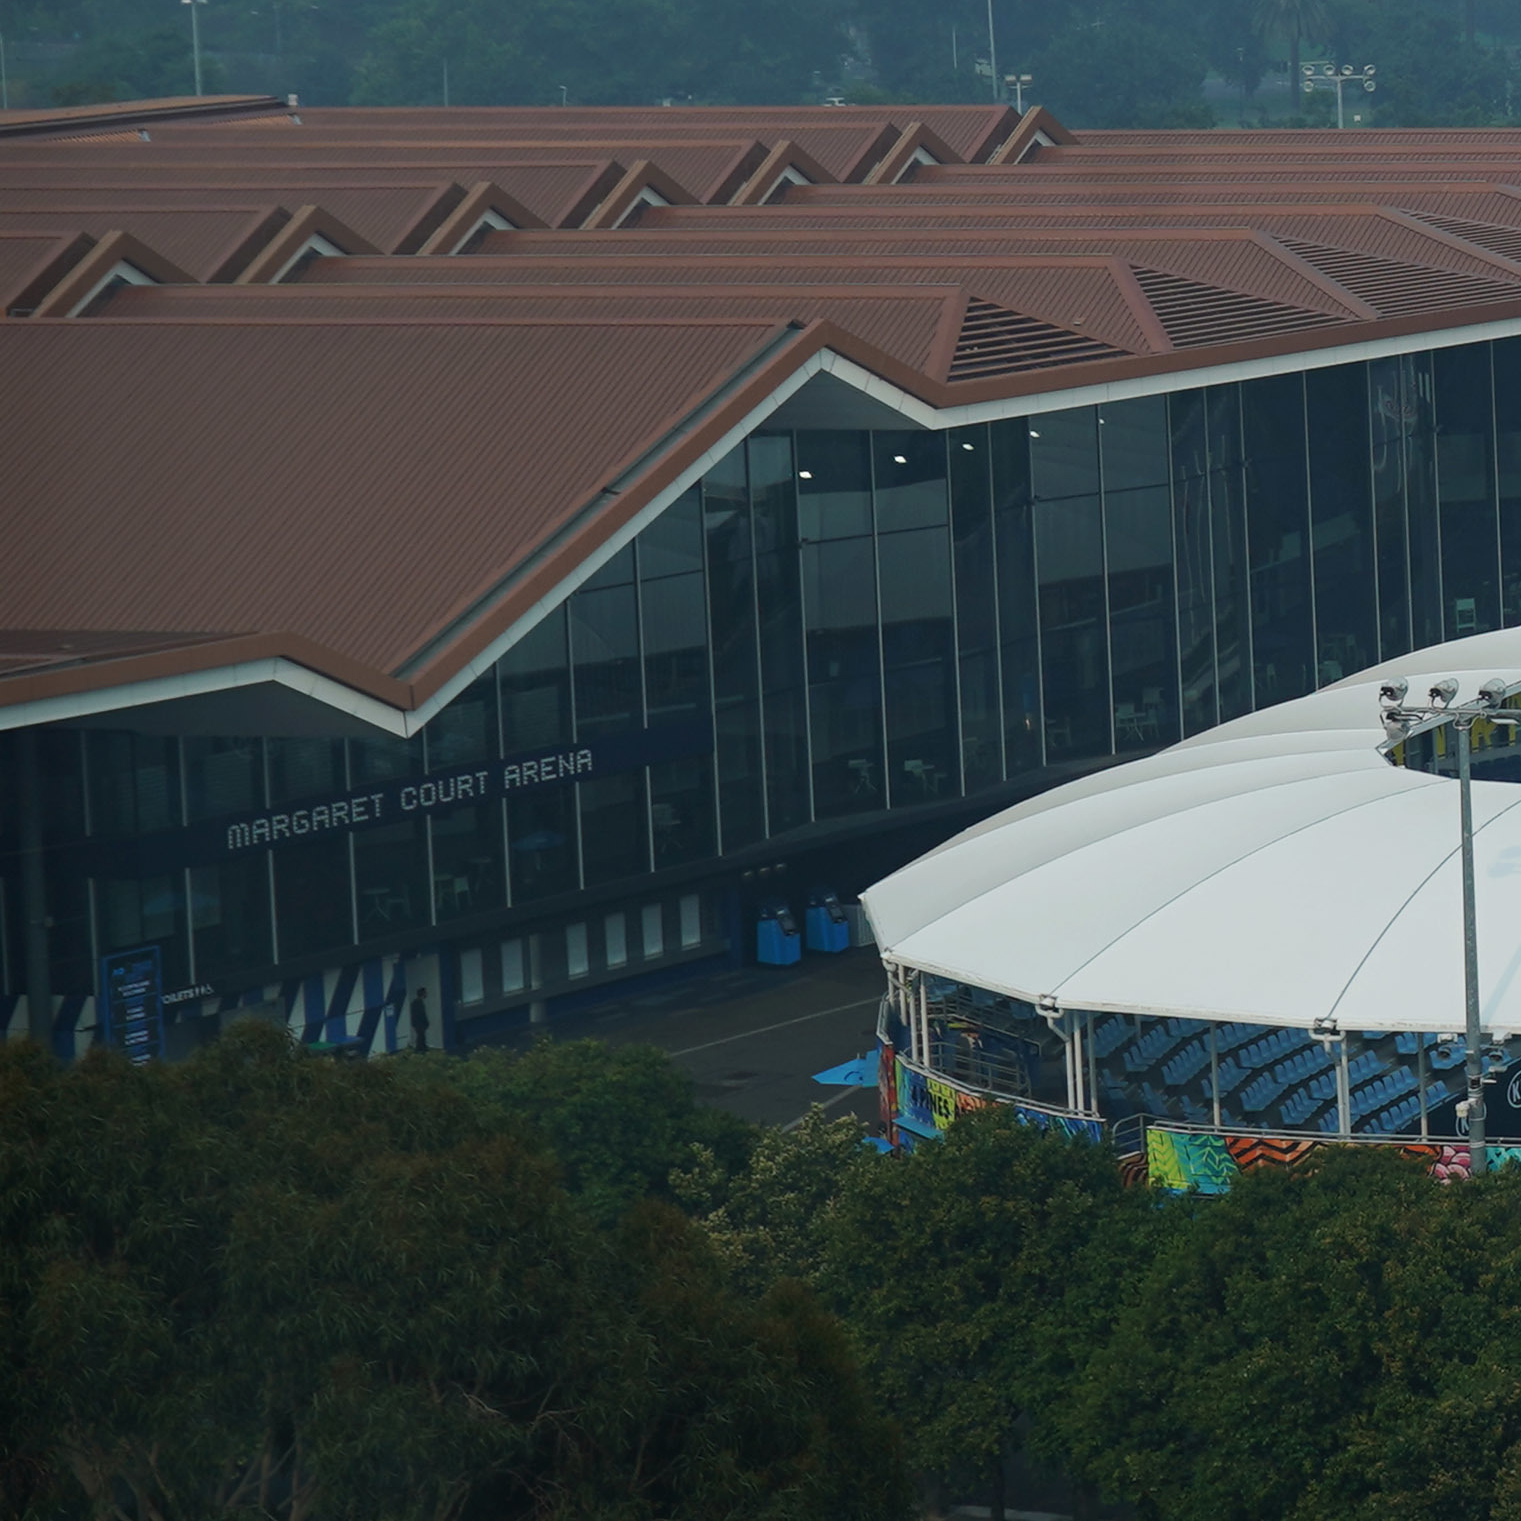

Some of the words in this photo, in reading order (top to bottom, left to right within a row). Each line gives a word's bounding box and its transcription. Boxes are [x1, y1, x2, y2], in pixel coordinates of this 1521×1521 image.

[227, 792, 384, 850] MARGARET
[400, 771, 489, 811] COURT
[503, 749, 593, 790] ARENA
